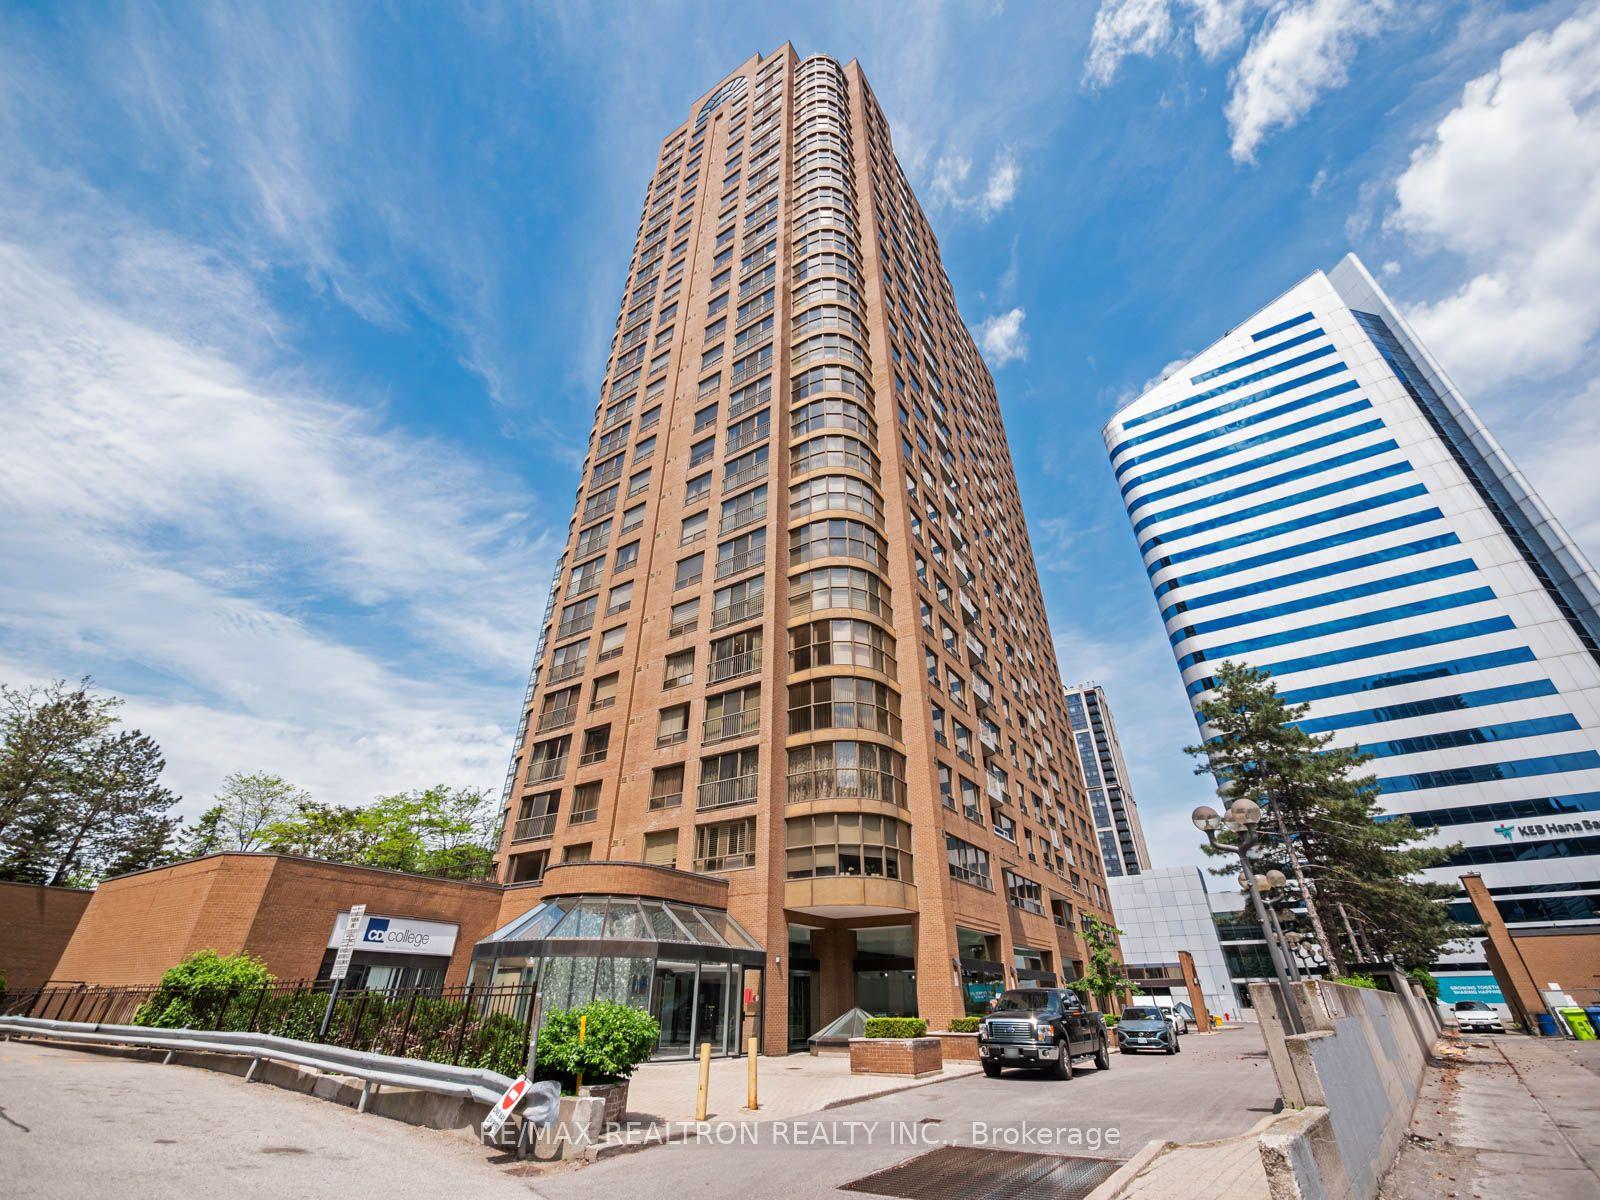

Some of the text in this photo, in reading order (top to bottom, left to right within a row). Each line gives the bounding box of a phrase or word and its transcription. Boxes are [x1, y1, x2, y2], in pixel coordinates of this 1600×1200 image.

[1518, 824, 1546, 836] KEB
[1545, 822, 1583, 834] Hana
[388, 929, 430, 947] college
